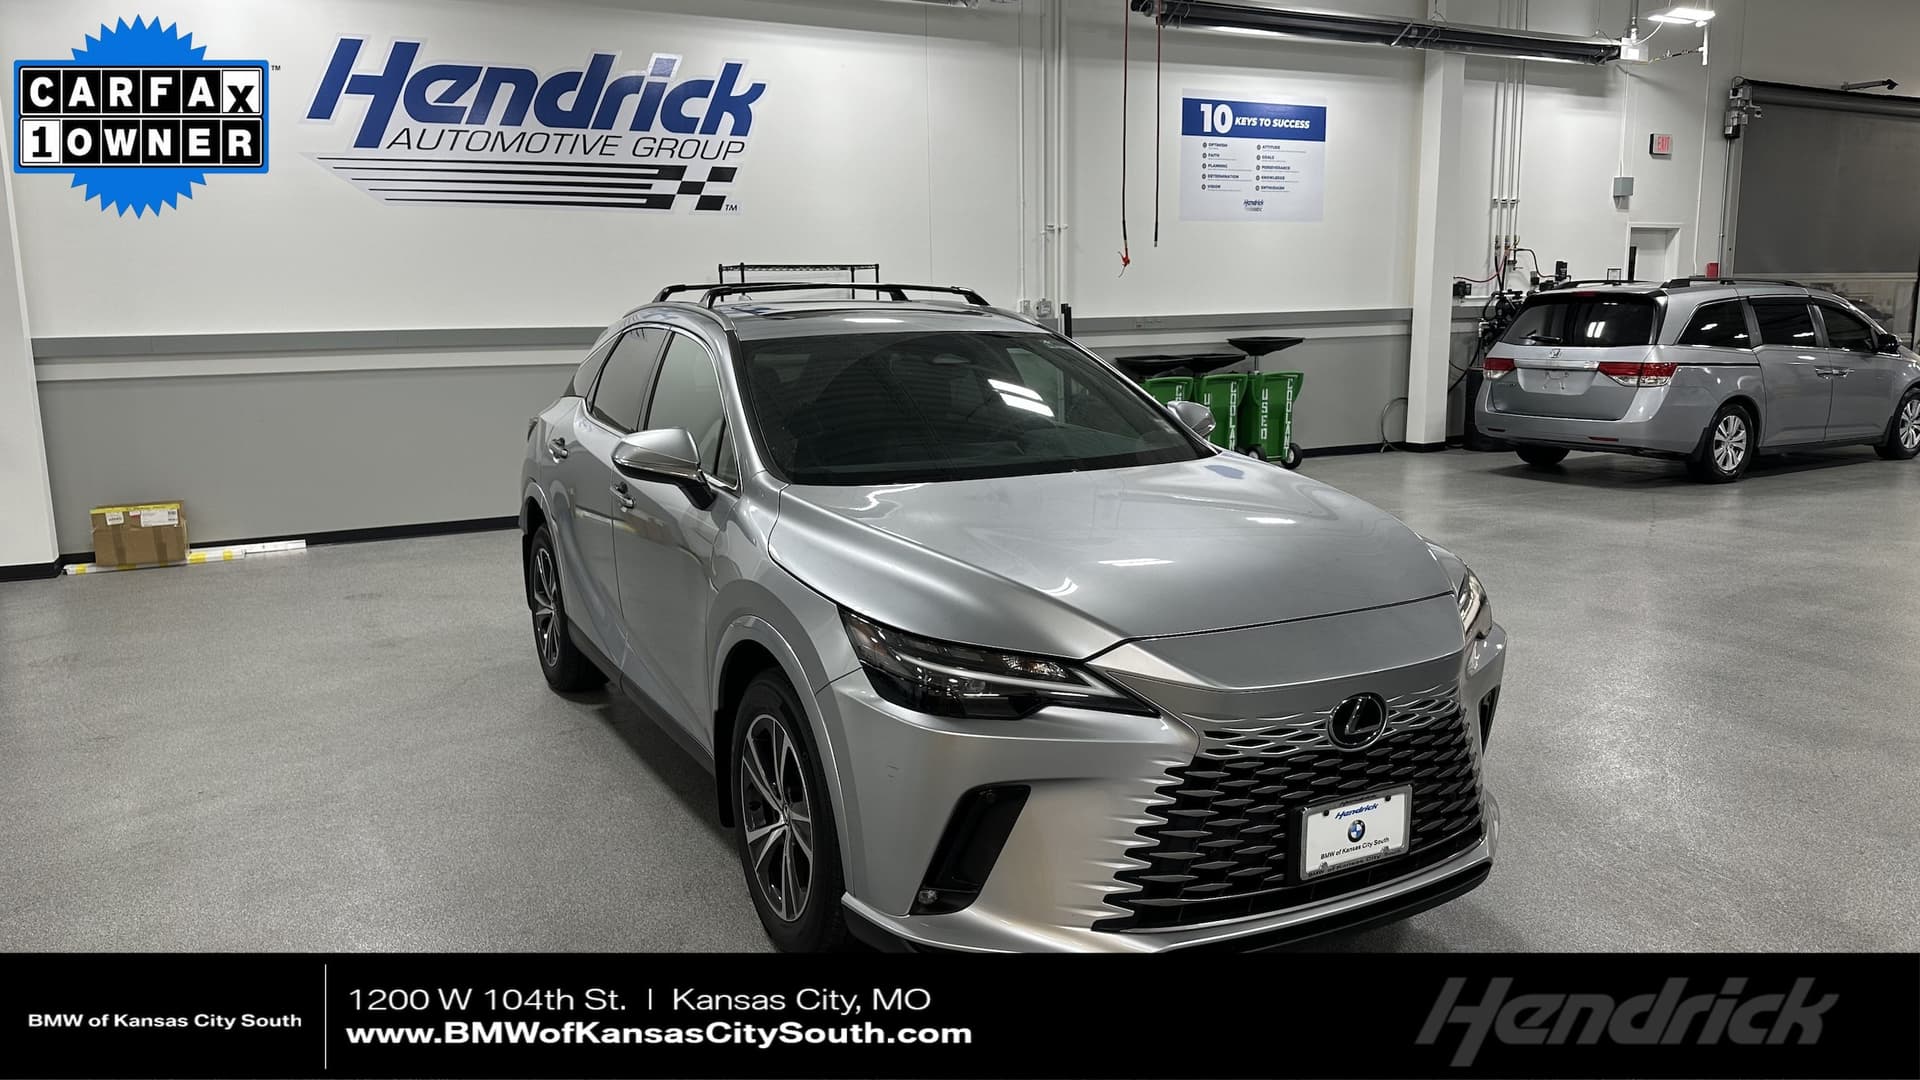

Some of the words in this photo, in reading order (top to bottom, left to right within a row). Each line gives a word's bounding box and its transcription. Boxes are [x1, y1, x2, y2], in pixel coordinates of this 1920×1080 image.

[306, 38, 767, 149] Hendrick
[1200, 103, 1234, 134] 10
[1234, 116, 1258, 127] KEYS
[1259, 118, 1272, 127] TO
[1272, 118, 1311, 129] SUCCESS
[386, 127, 622, 157] AUTOMOTIVE
[632, 137, 746, 161] GROUP
[1229, 381, 1237, 451] COOLAN
[1261, 388, 1269, 440] USED
[1283, 378, 1294, 458] COOLANT
[1335, 803, 1378, 820] Hendrick
[1342, 845, 1361, 854] Kansas
[1361, 841, 1373, 849] City
